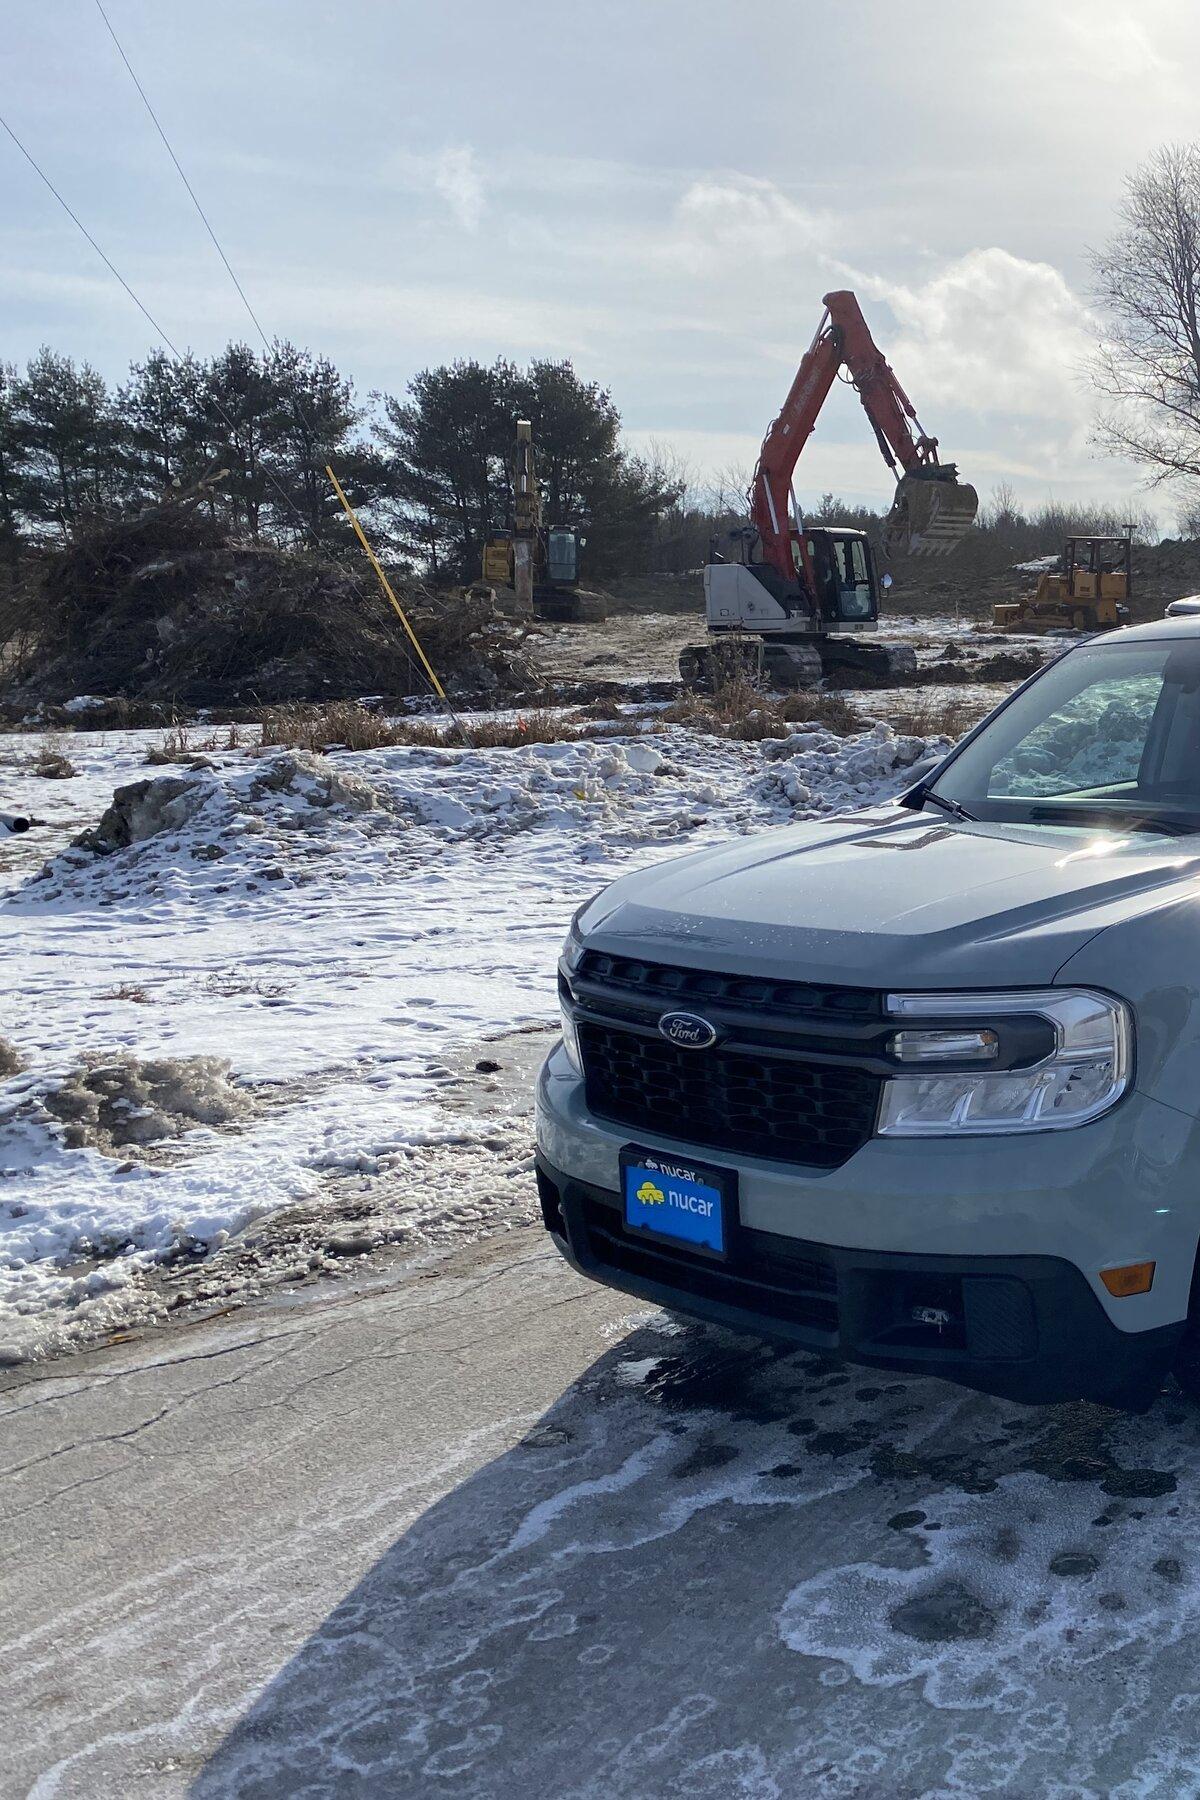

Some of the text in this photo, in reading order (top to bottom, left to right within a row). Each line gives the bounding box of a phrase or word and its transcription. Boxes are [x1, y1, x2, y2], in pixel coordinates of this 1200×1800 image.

[669, 1018, 700, 1041] Ford
[660, 1163, 696, 1182] nucar
[668, 1190, 713, 1217] nucar
